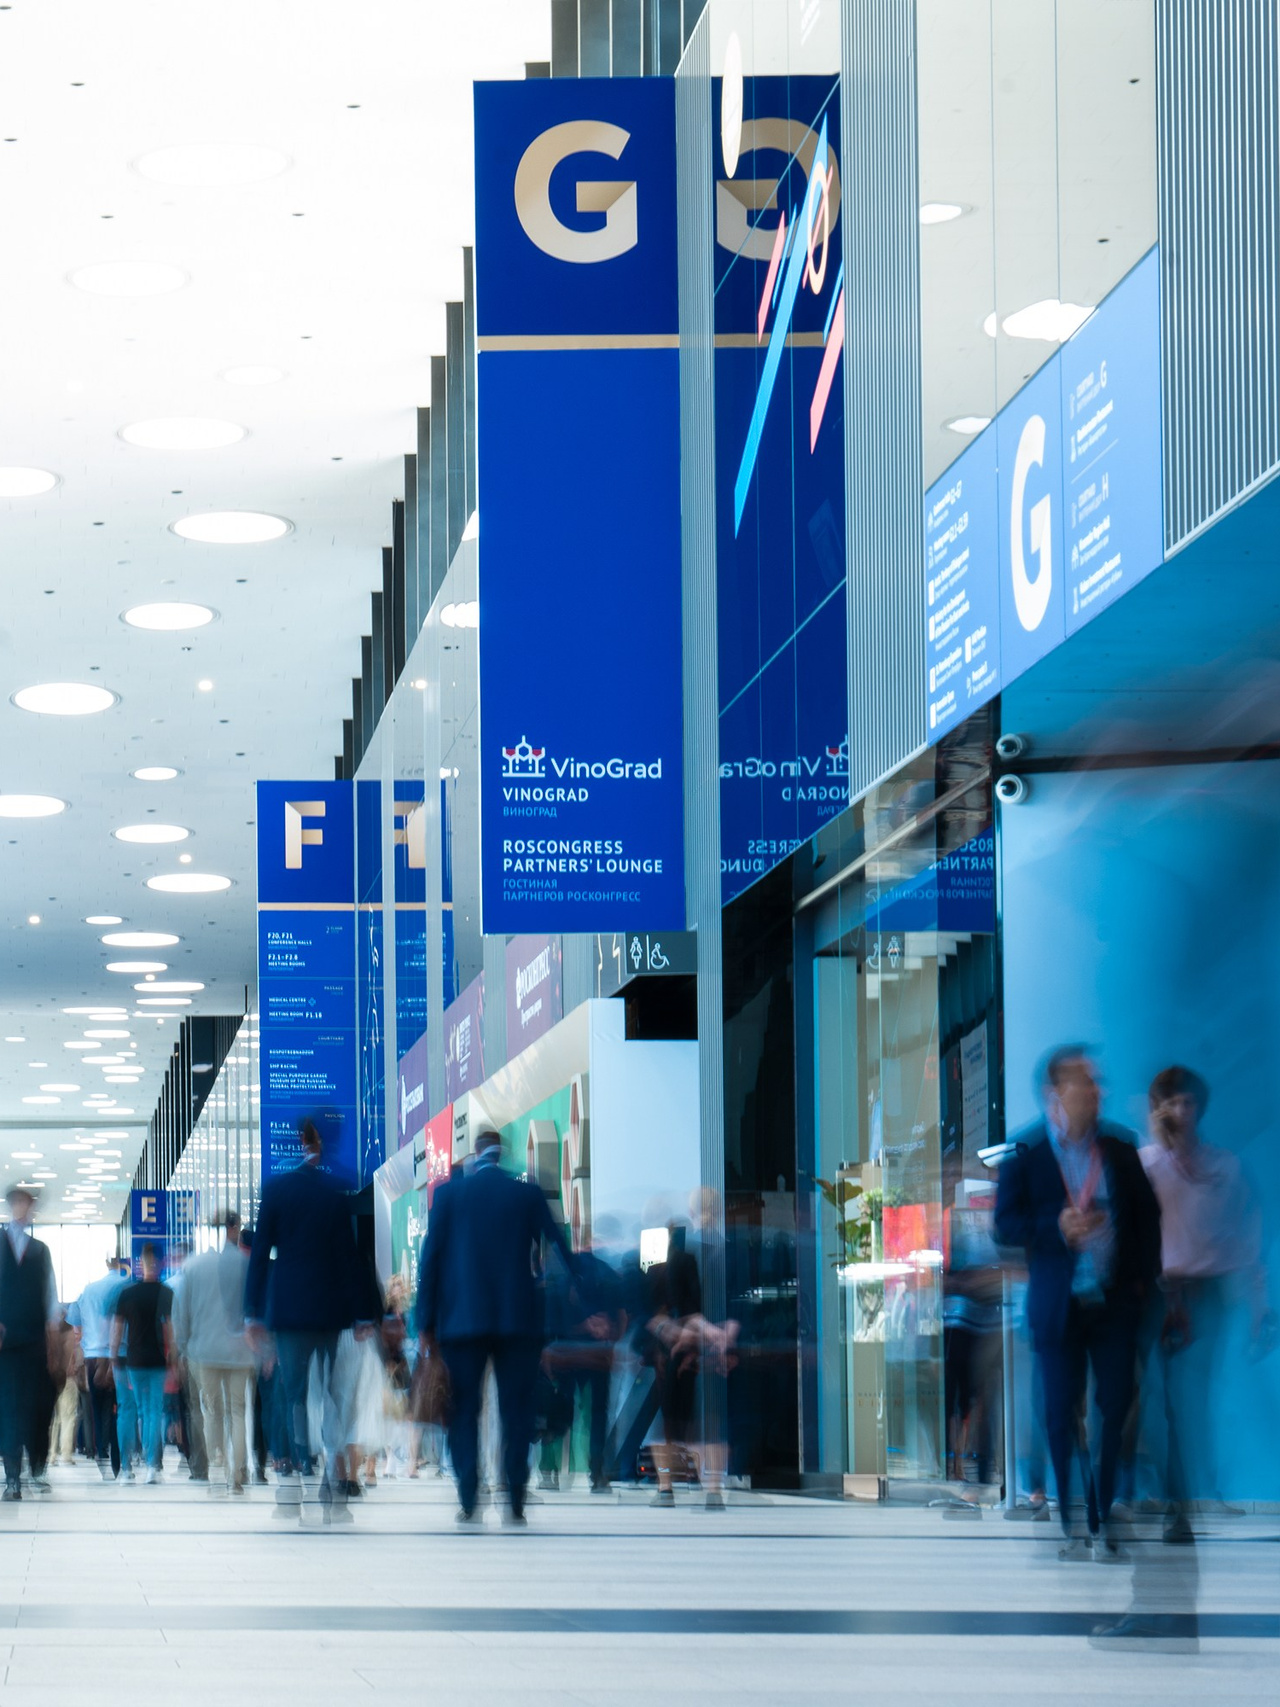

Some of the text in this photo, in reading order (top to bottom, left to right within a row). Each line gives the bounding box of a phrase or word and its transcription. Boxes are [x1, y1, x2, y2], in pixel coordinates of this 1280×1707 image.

[514, 118, 639, 265] G
[1010, 413, 1053, 633] G
[551, 757, 663, 779] VinoGrad
[503, 787, 590, 802] VINOGRAD
[503, 806, 558, 818] ВИНОГРАД
[285, 801, 326, 870] F
[503, 840, 624, 855] ROSCONGRESS
[503, 858, 664, 874] PARTNERS' LOUNGE
[503, 879, 558, 889] ГОСТИНАЯ
[503, 891, 642, 903] ПАРТНЕРОВ РОСКОНГРЕСС
[141, 1196, 157, 1223] E
